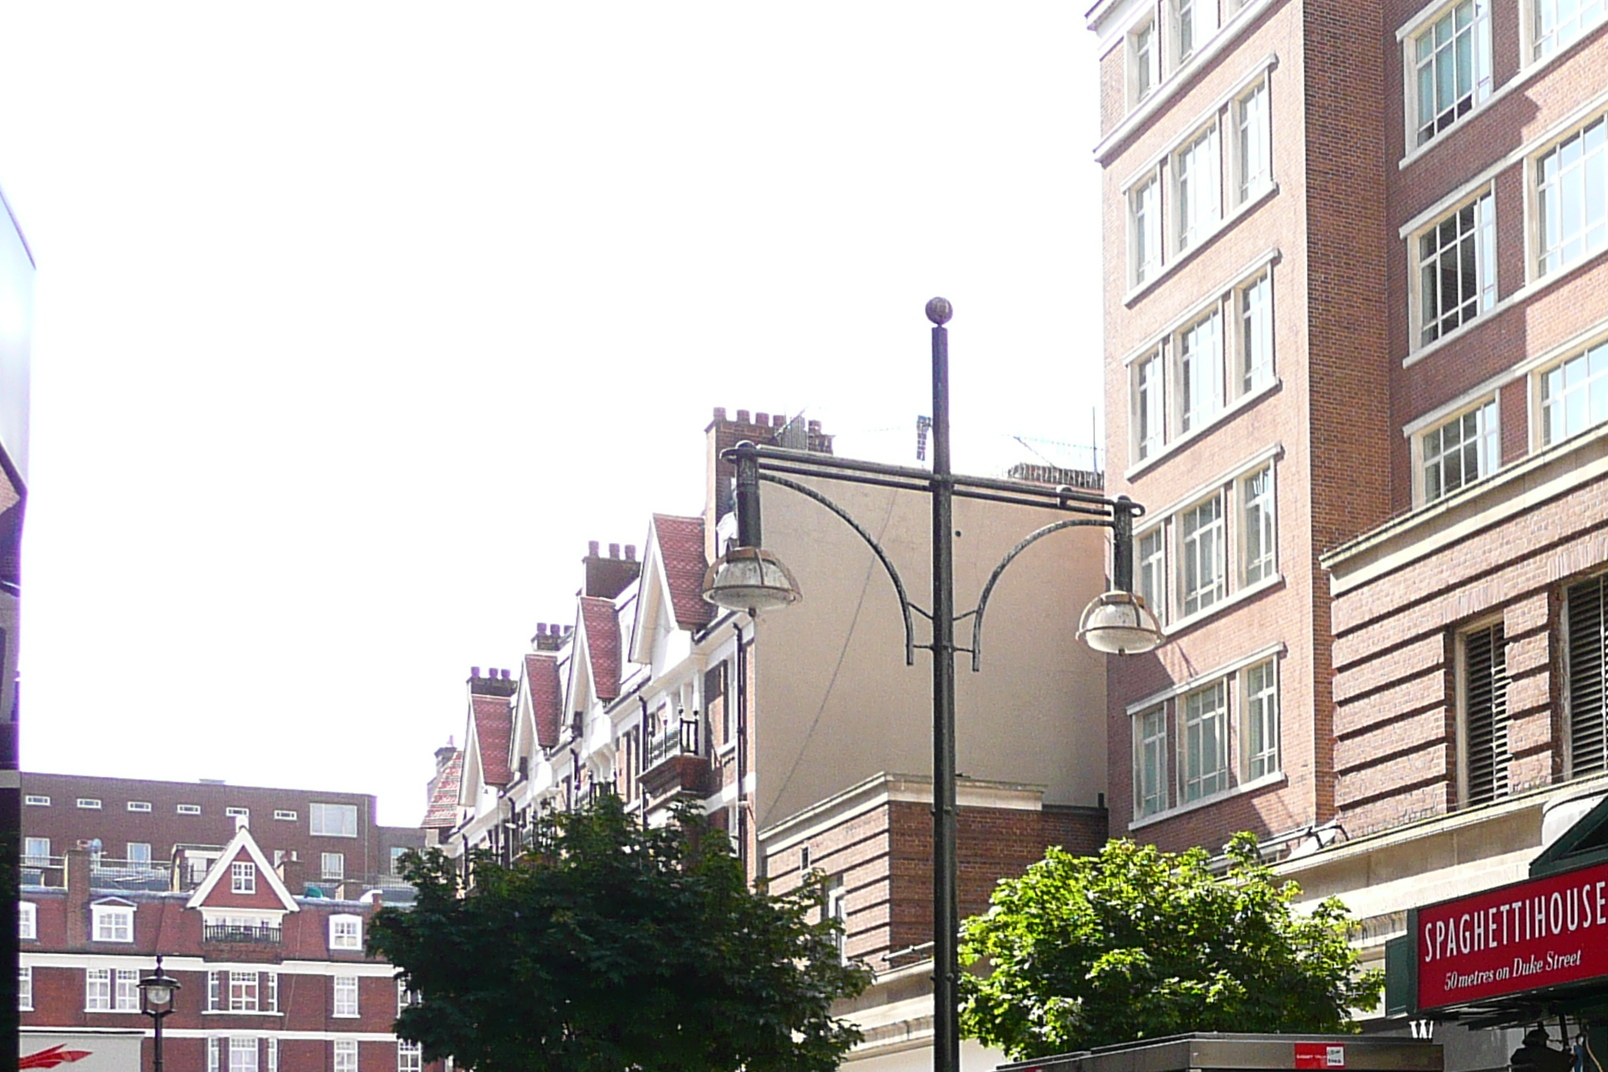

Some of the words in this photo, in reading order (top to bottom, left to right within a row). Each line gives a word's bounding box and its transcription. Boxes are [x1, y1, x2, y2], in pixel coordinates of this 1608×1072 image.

[1424, 880, 1608, 963] SPAGHETTIHOUSE
[1443, 971, 1458, 991] 50
[1458, 968, 1495, 988] metres
[1496, 966, 1510, 981] on
[1512, 954, 1544, 978] Duke
[1545, 949, 1582, 971] Street
